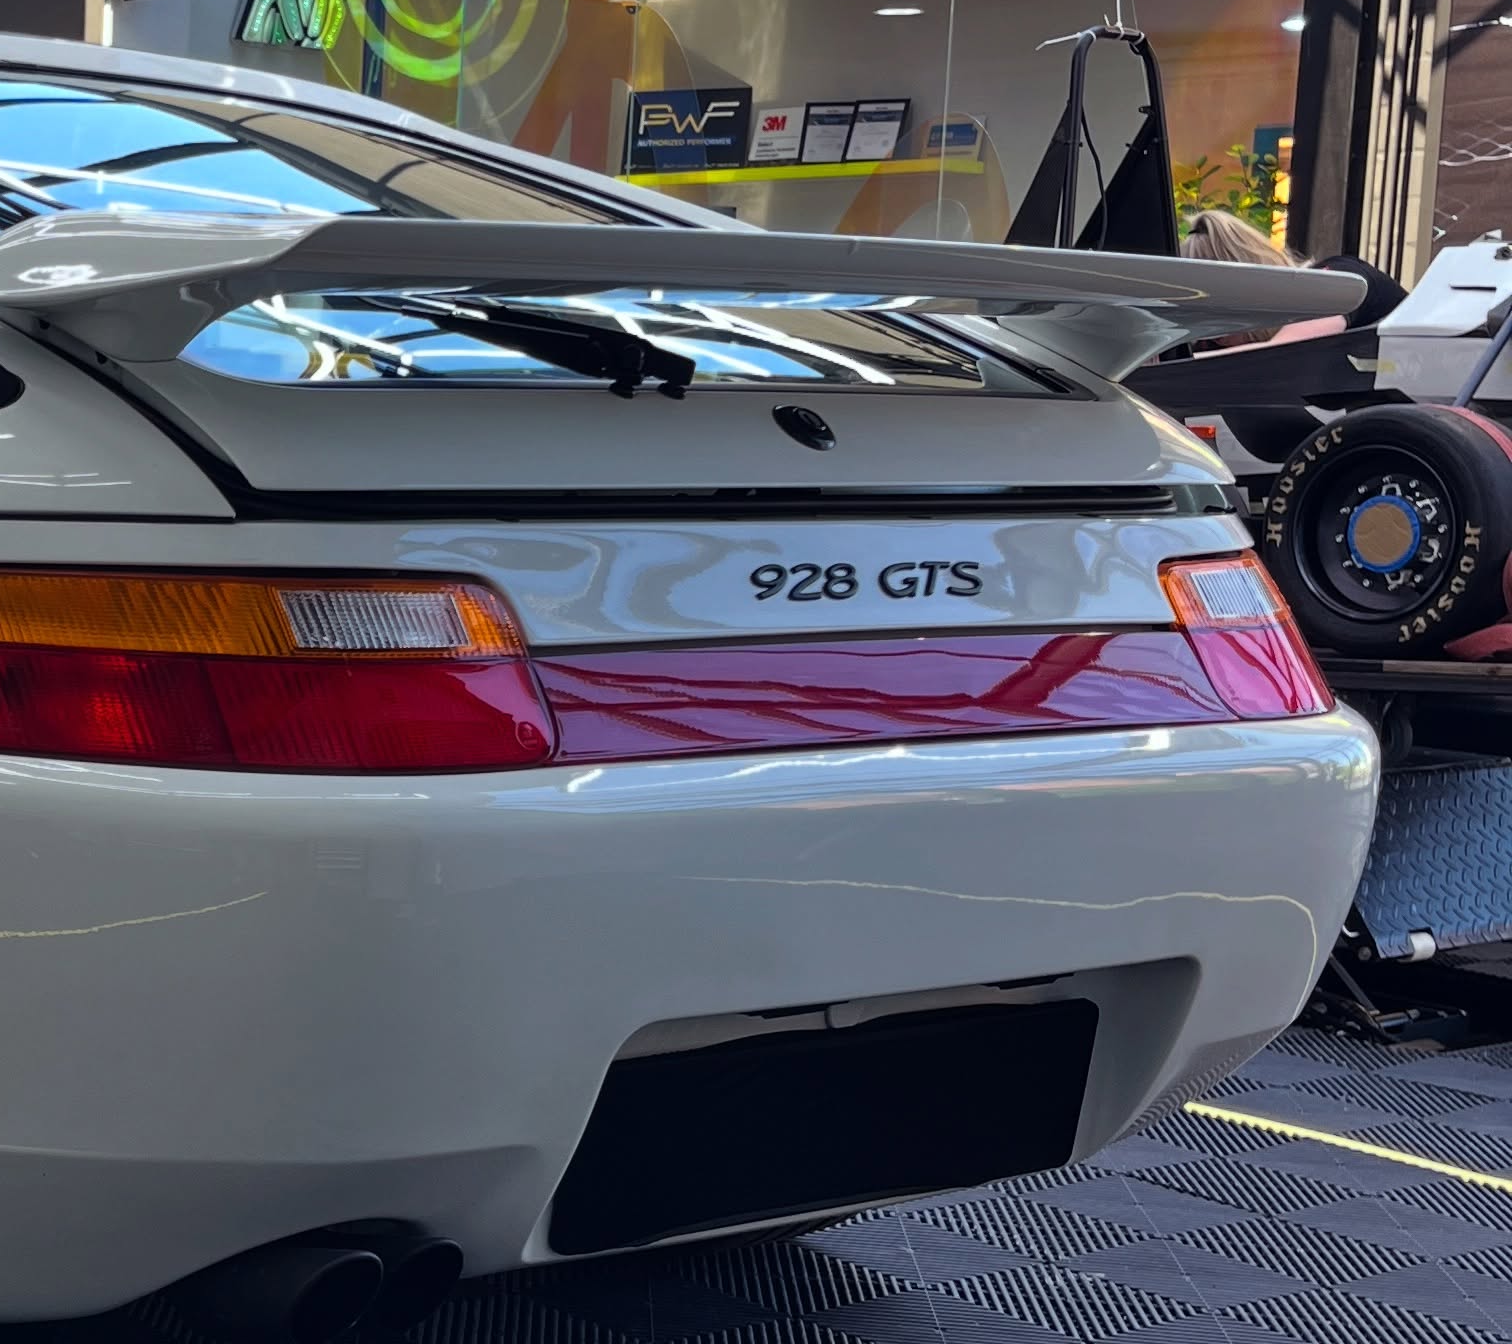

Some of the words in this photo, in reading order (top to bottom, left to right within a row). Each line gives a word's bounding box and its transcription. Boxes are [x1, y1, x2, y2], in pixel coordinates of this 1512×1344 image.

[638, 101, 740, 135] PWF
[762, 115, 788, 132] 3M
[637, 138, 685, 147] AUTHORIZED
[687, 137, 732, 146] PERFORMER
[1265, 426, 1343, 548] Hoosier
[750, 563, 860, 602] 928
[878, 560, 985, 599] GTS
[1398, 519, 1482, 643] Hoosier
